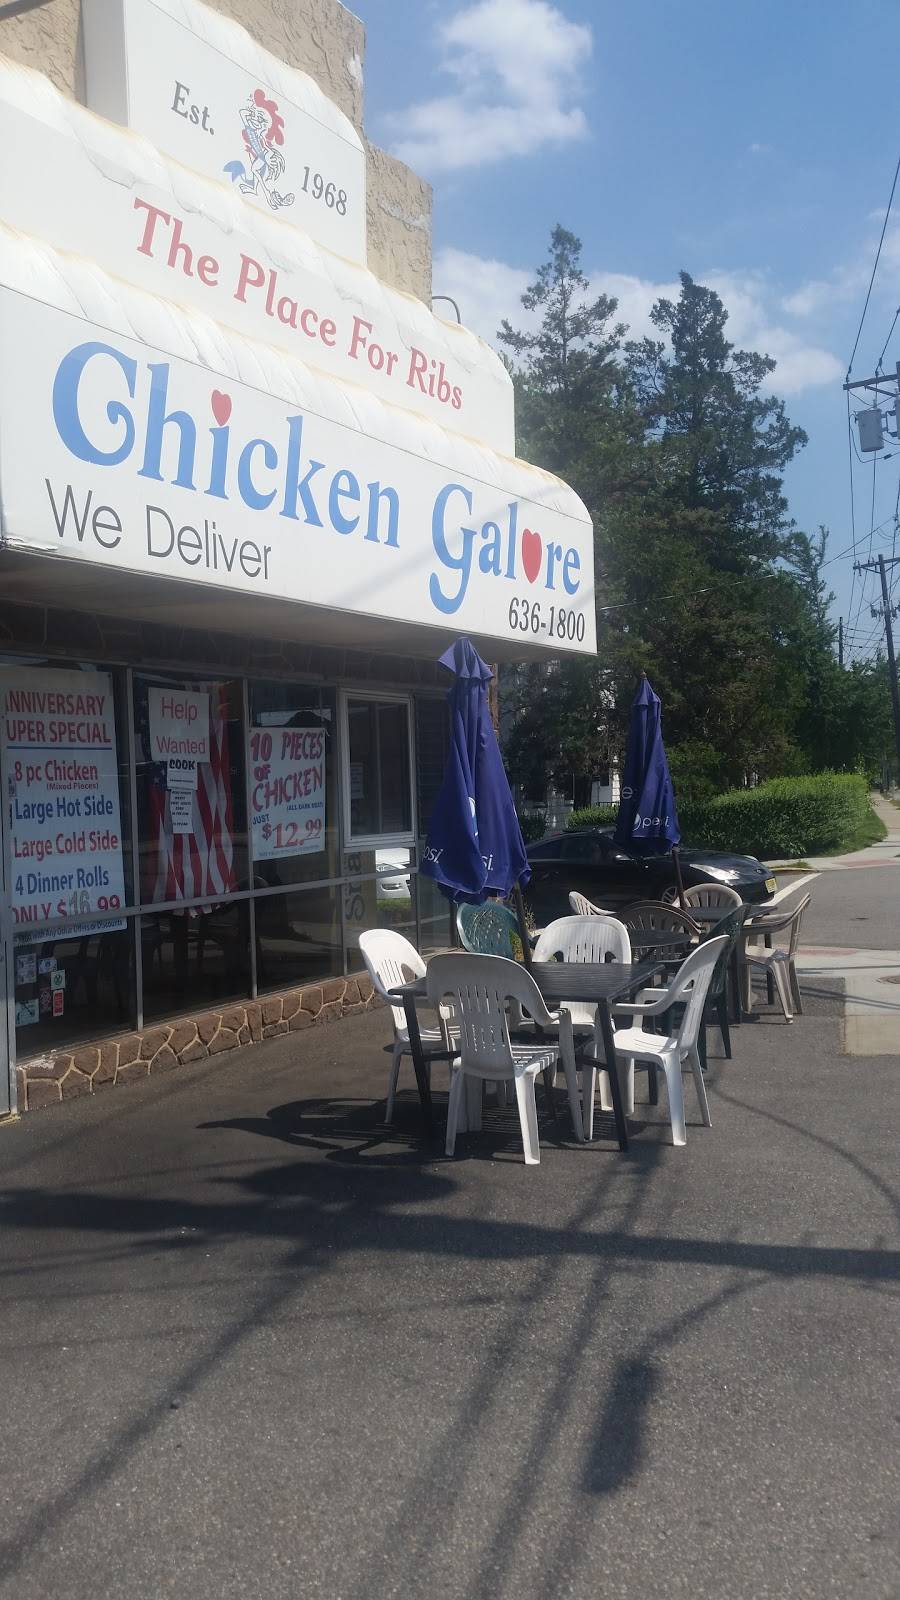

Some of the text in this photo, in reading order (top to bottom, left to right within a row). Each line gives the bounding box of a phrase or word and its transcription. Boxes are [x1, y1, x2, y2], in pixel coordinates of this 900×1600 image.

[171, 80, 215, 135] Est.
[301, 166, 348, 217] 1968
[133, 197, 462, 410] The Place For Ribs
[52, 341, 401, 548] Chicken
[45, 478, 272, 580] We Deliver
[508, 597, 585, 642] 636-1800
[161, 697, 198, 725] Help
[49, 721, 112, 743] SPECIAL
[156, 735, 206, 754] Wanted
[250, 731, 324, 762] 10 PIECES
[14, 761, 23, 781] 8
[26, 764, 42, 787] pc
[45, 759, 98, 781] Chicken
[169, 759, 196, 770] COOK
[254, 764, 271, 782] OF
[252, 761, 323, 813] CHICKEN
[15, 794, 113, 825] Large Hot Side
[252, 813, 270, 825] JUST
[14, 829, 119, 862] Large Cold Side
[15, 865, 110, 896] 4 Dinner Rolls
